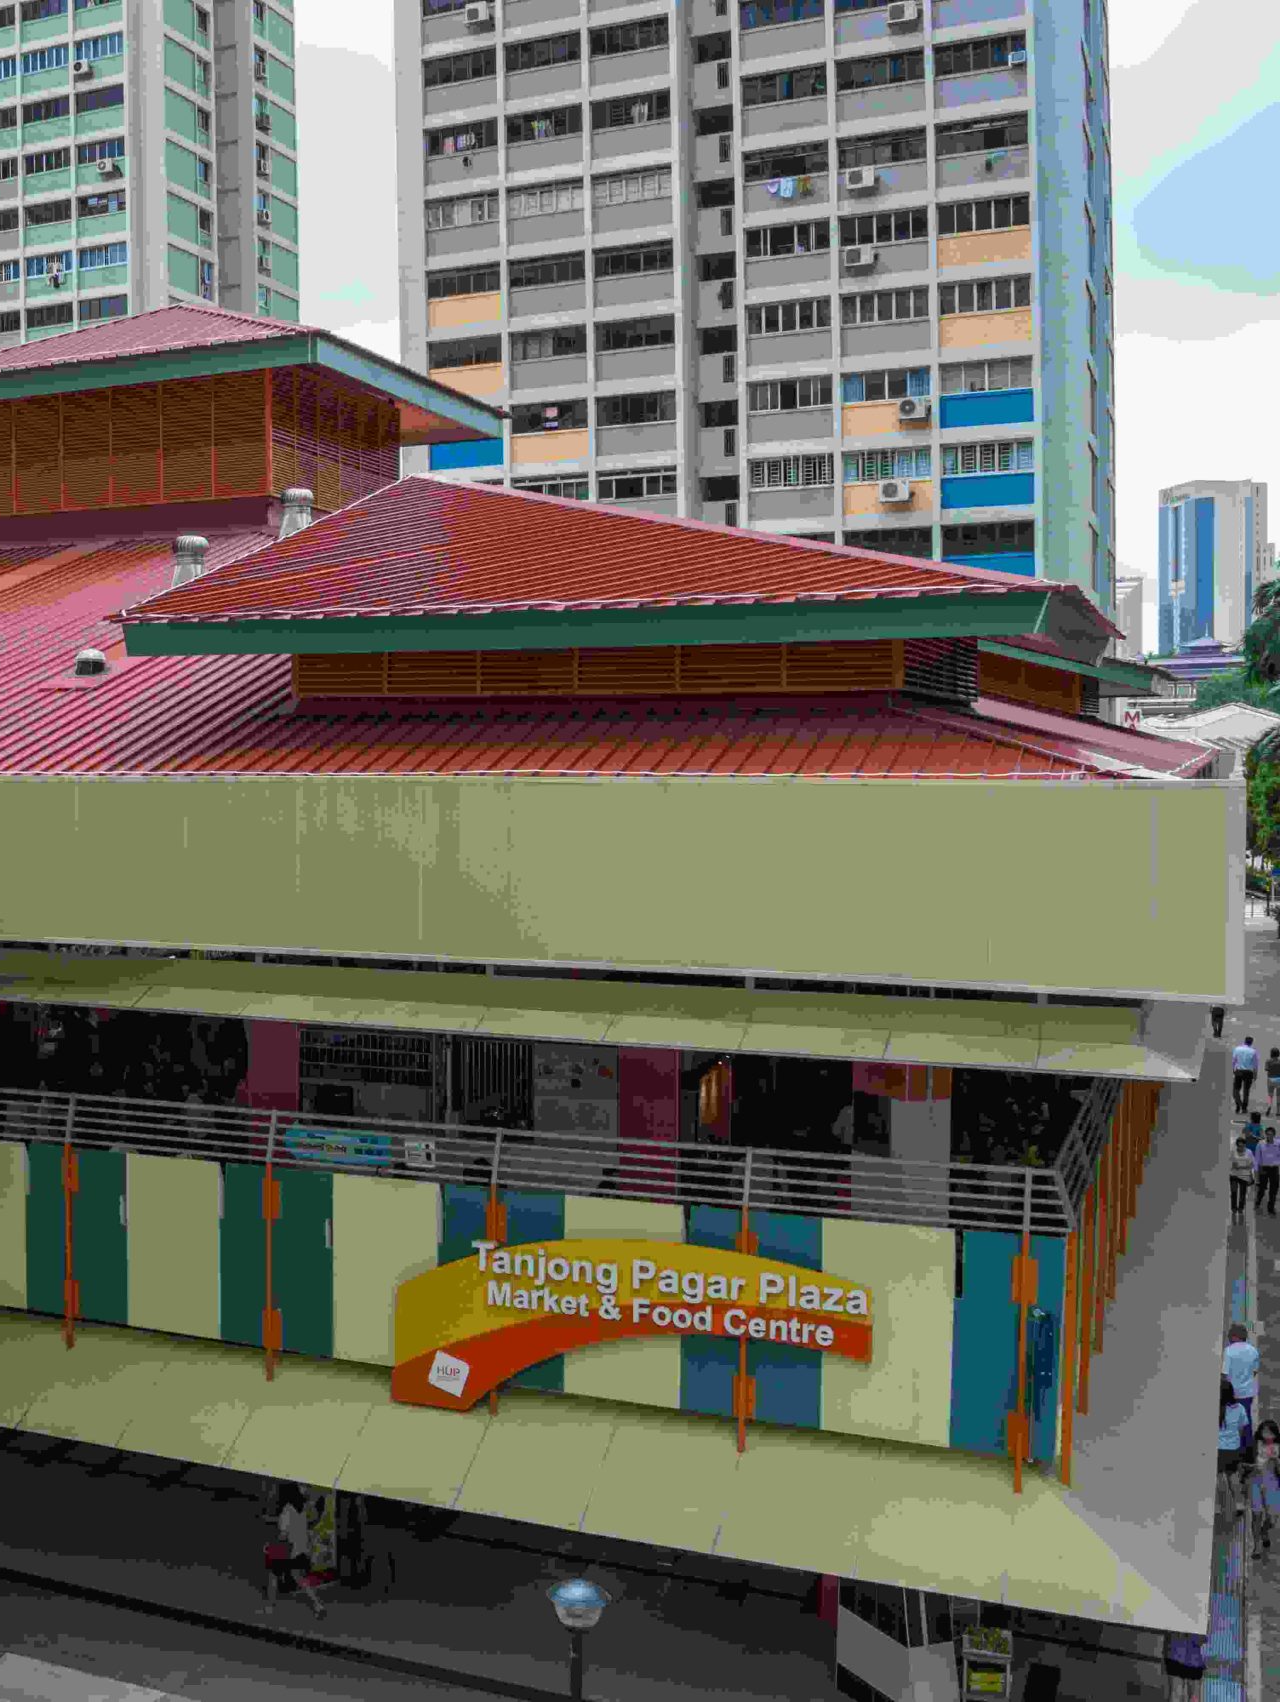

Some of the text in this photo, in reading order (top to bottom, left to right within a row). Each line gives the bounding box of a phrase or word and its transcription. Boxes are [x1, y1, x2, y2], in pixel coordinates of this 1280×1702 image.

[472, 1239, 869, 1315] Tanjong Pagar Plaza
[487, 1280, 835, 1346] Market & Food Centre
[436, 1365, 461, 1377] HUP
